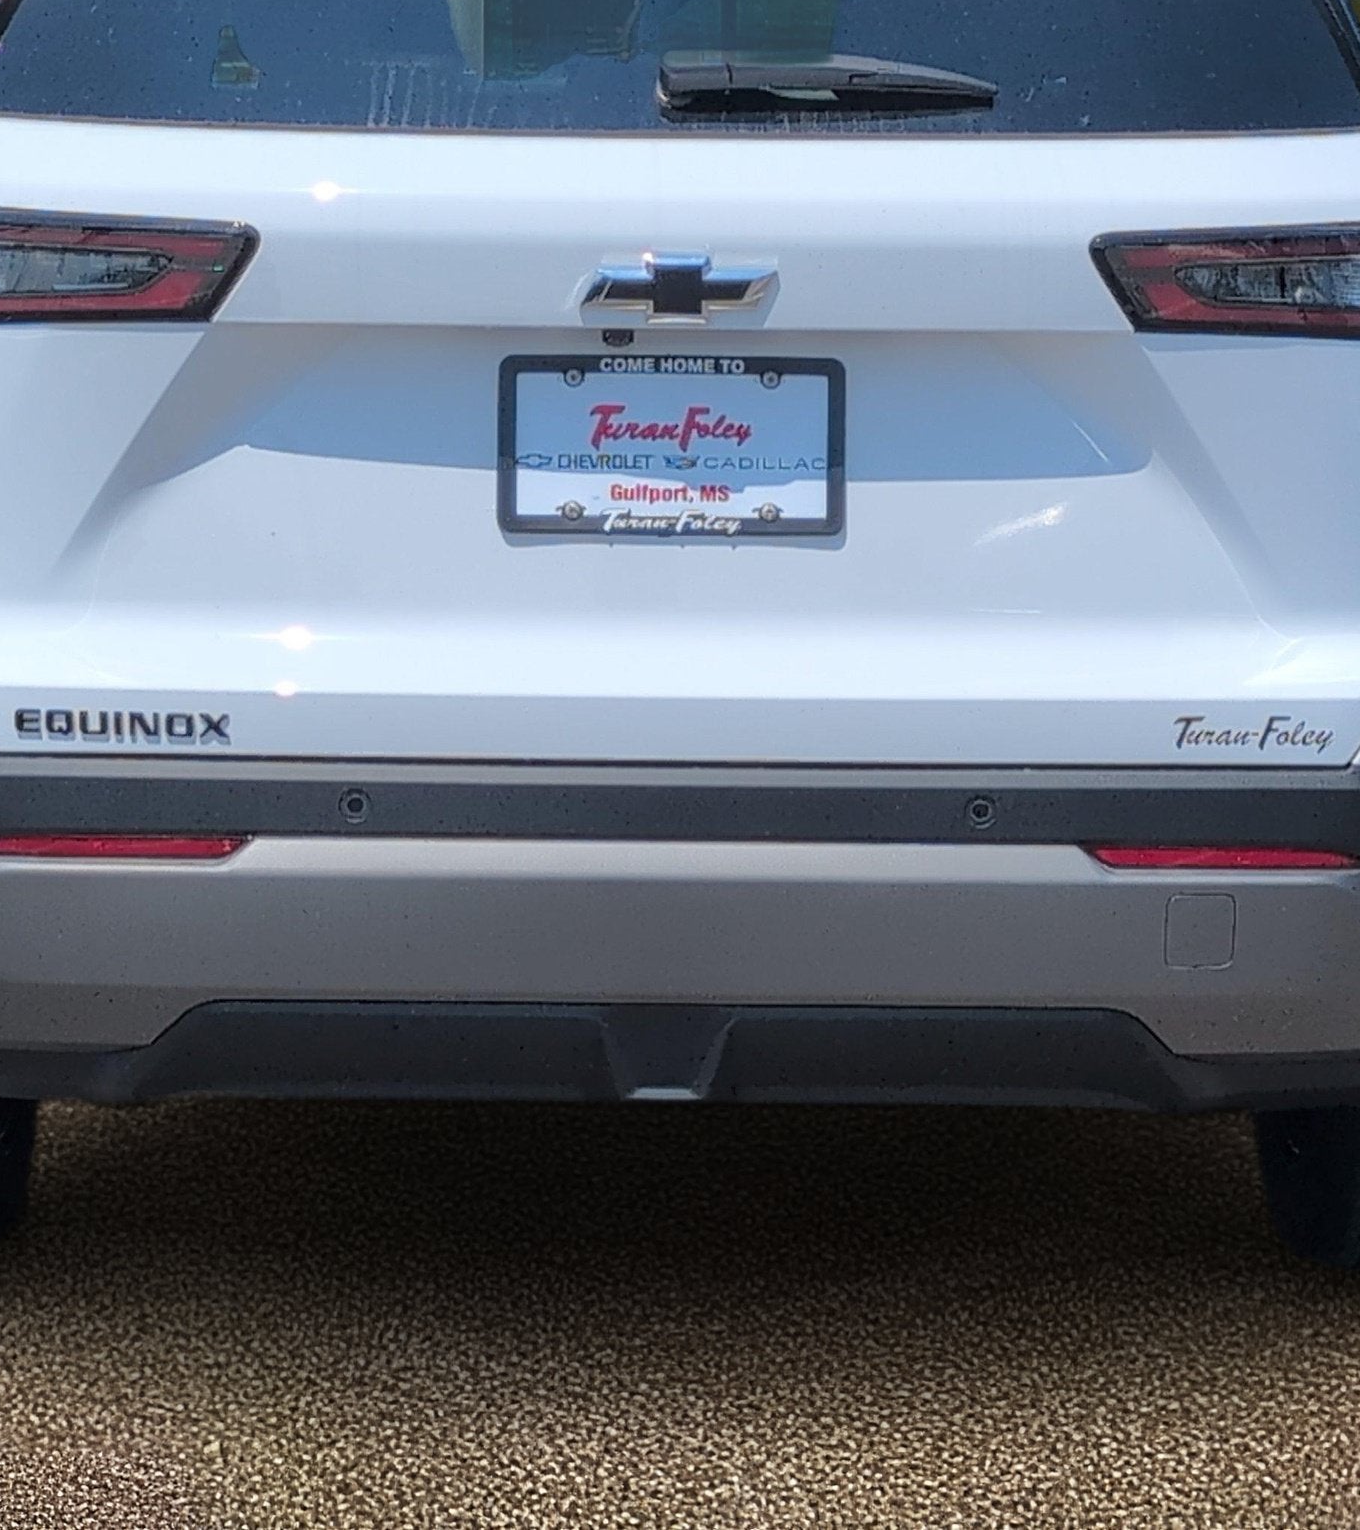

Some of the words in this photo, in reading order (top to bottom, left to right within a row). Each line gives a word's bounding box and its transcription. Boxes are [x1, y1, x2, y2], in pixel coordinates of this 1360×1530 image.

[599, 357, 656, 373] COME
[660, 358, 716, 373] HOME
[719, 359, 746, 374] TO
[557, 454, 656, 470] CHEVROLET
[703, 456, 828, 471] CADILLAC
[610, 483, 693, 504] Gulfport,
[699, 484, 731, 503] MS
[14, 708, 231, 744] EQUINOX
